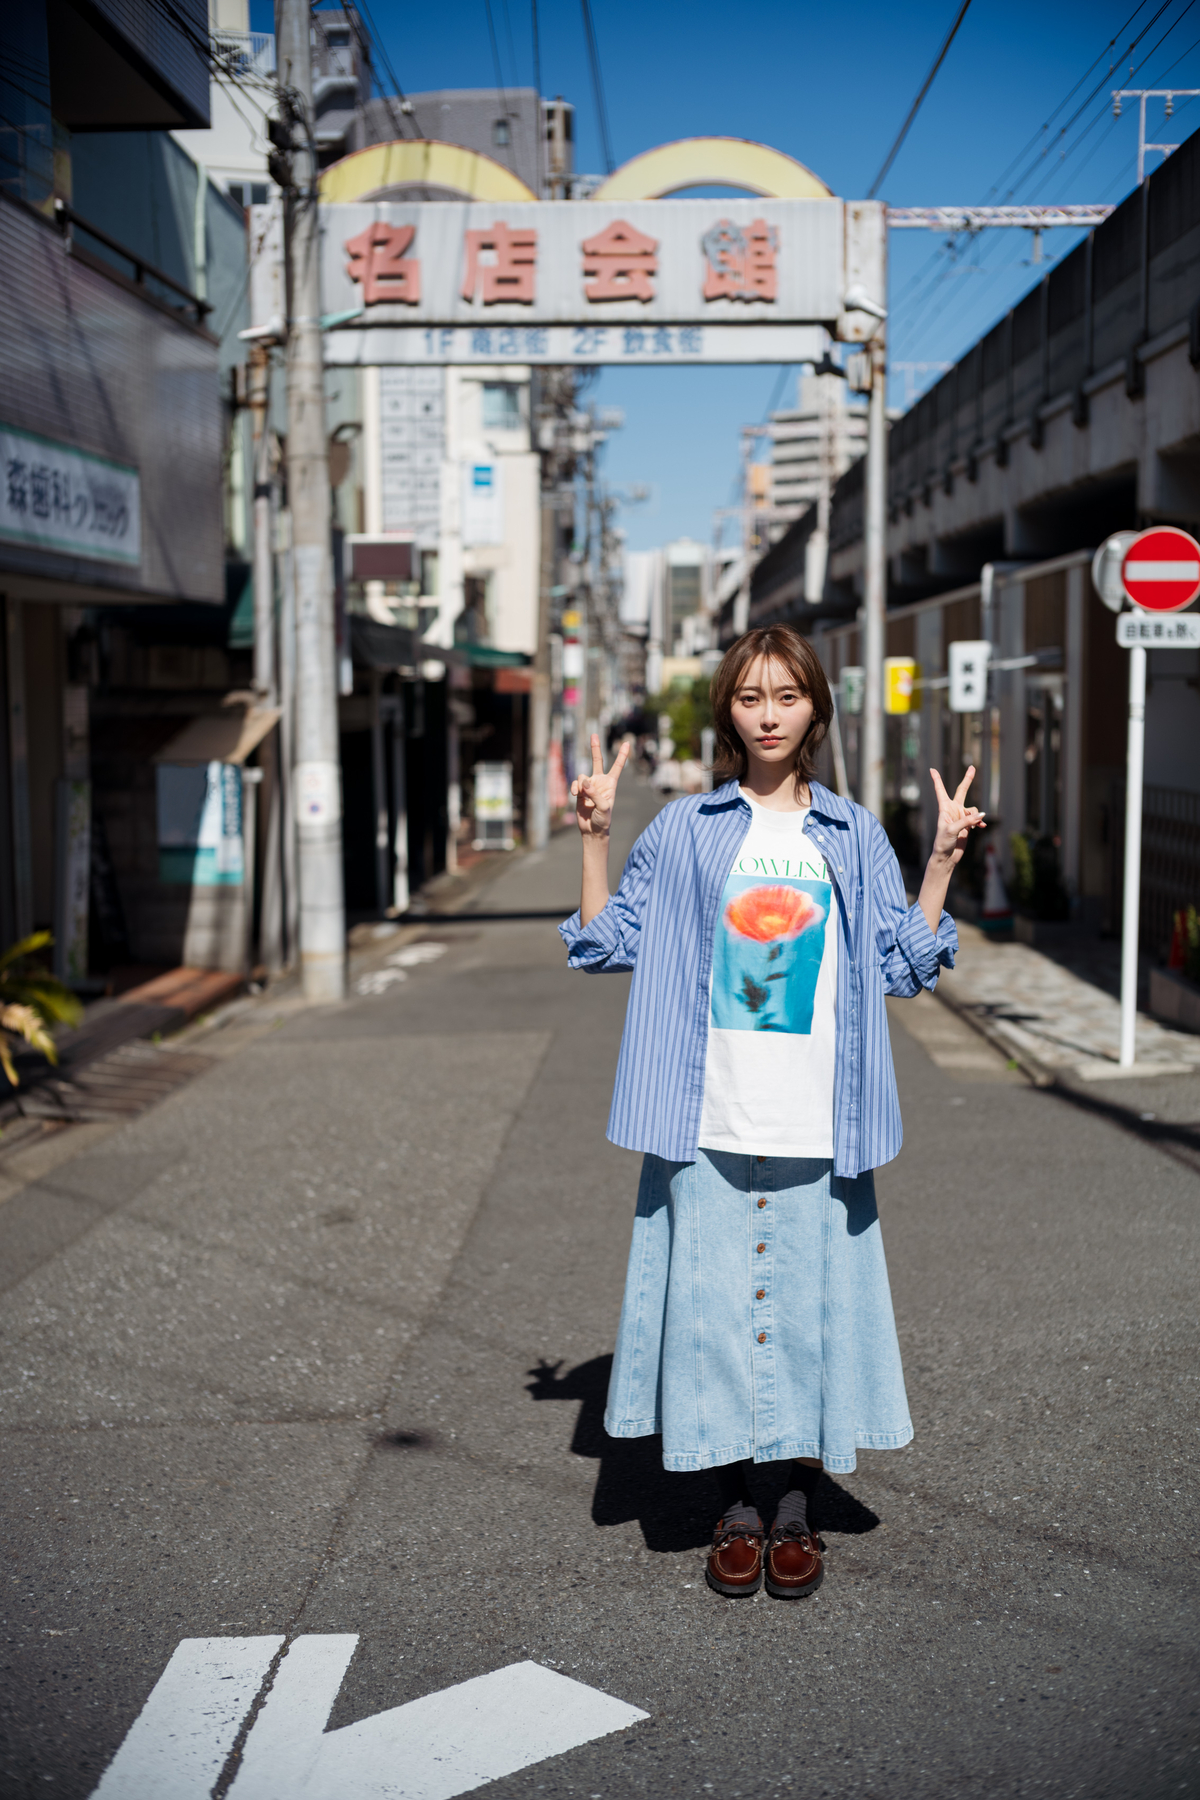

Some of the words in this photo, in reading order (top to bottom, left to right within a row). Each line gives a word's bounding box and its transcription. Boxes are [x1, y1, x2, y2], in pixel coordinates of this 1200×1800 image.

[347, 221, 779, 304] 名店会館
[425, 327, 454, 354] 1F
[573, 327, 607, 354] 2F
[732, 857, 832, 882] OWLINE
